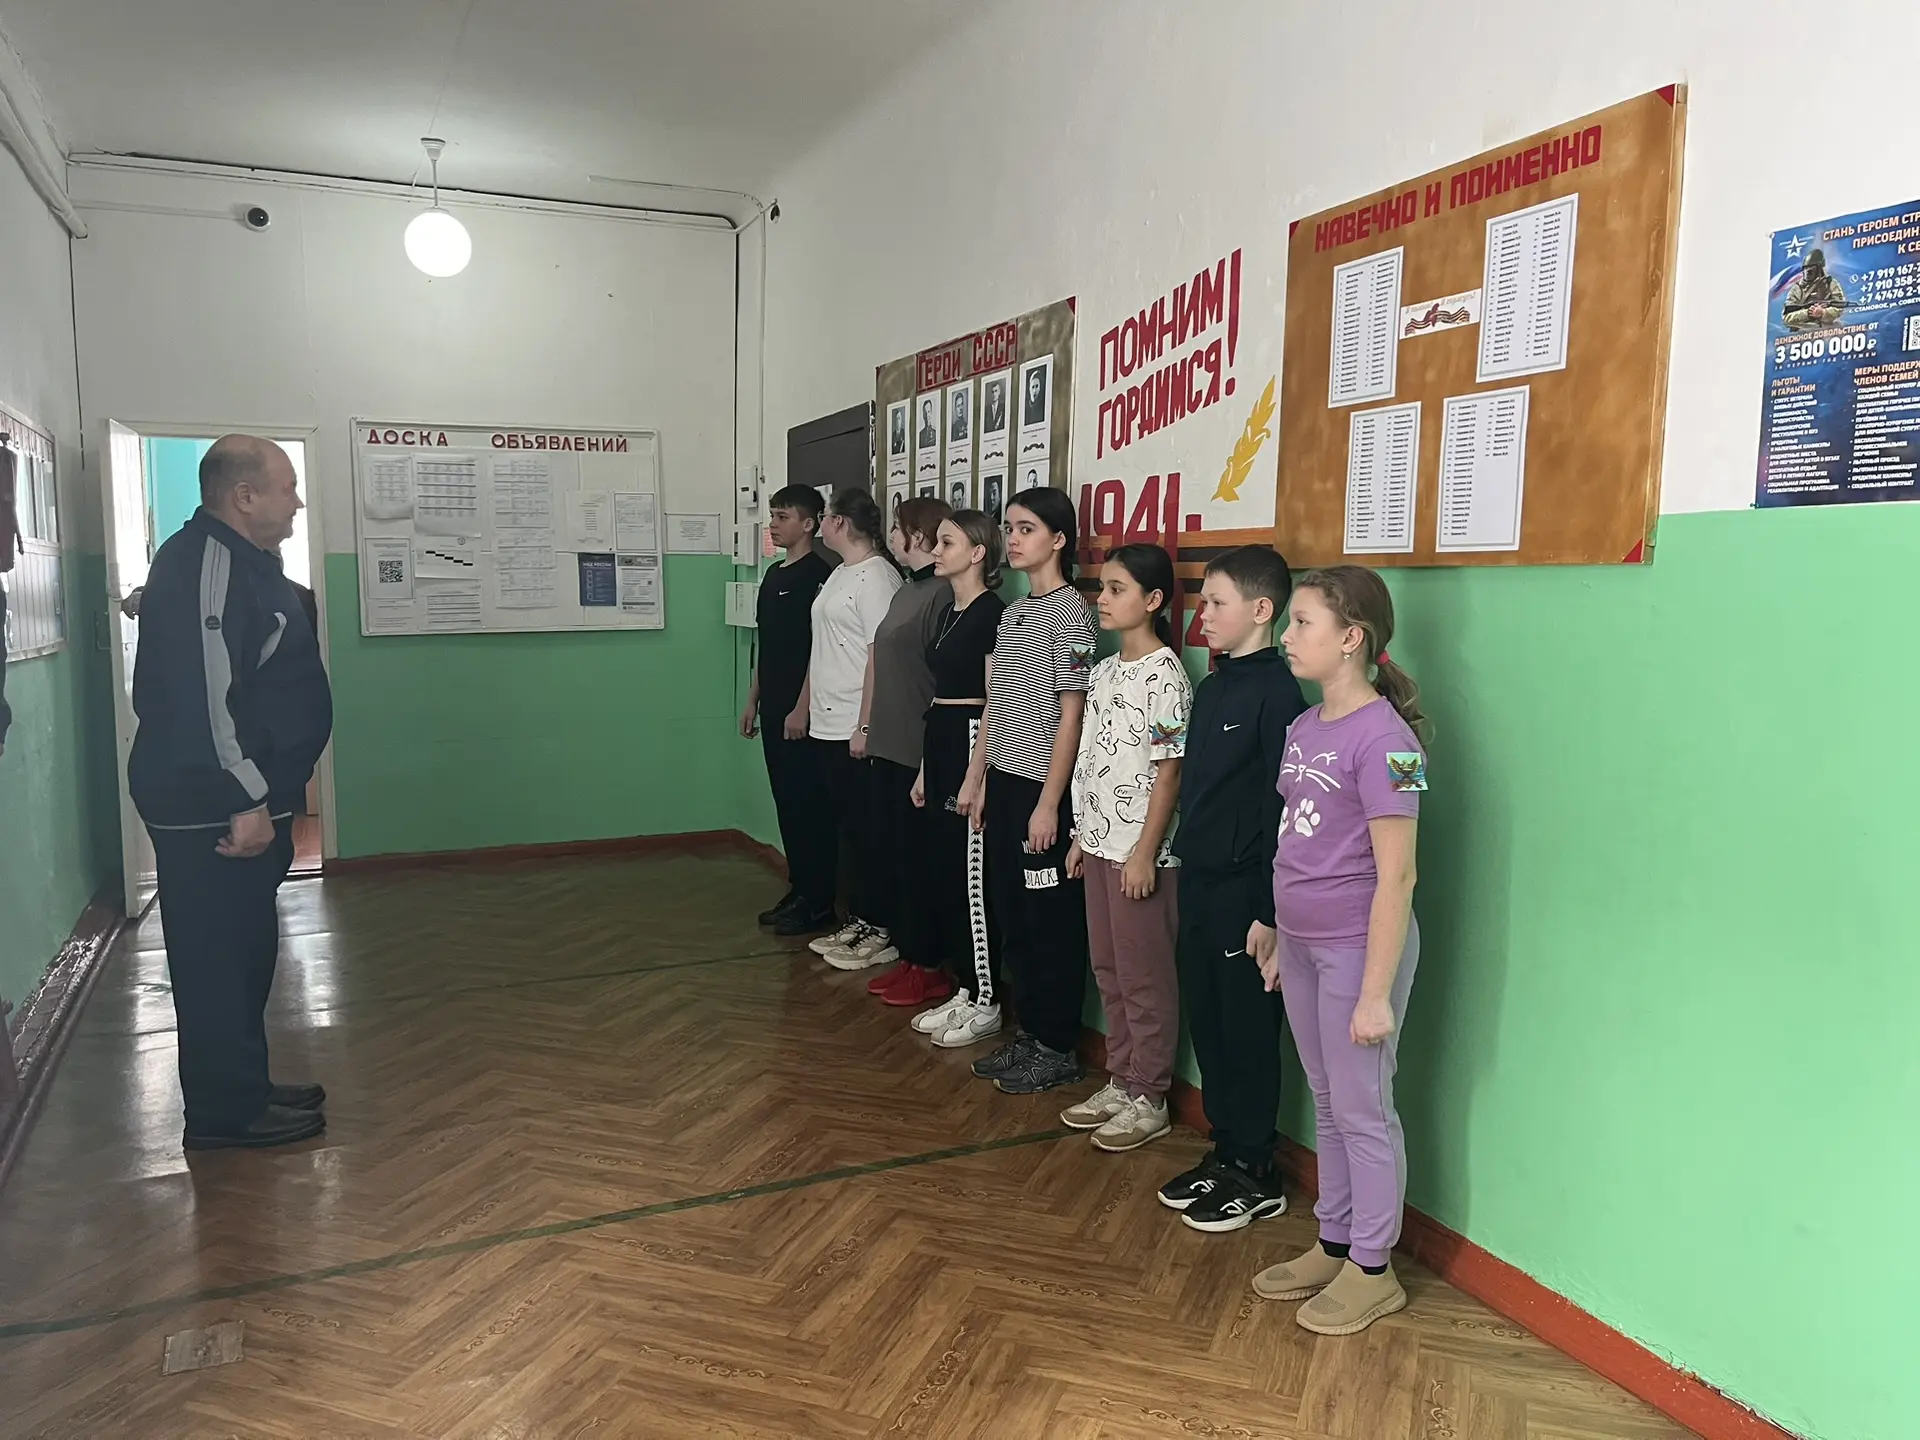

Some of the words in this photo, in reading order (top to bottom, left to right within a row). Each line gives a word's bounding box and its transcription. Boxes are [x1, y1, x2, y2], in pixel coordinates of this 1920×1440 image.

[1315, 190, 1417, 252] НАВЕЧНО
[1424, 182, 1442, 218] И
[1450, 125, 1602, 209] ПОИМЕННО
[1824, 226, 1854, 240] СТАНЬ
[1858, 216, 1899, 234] ГЕРОЕМ
[1898, 243, 1906, 254] К
[1862, 270, 1874, 281] +7
[1877, 267, 1895, 280] 919
[1861, 282, 1874, 292] +7
[1876, 279, 1892, 290] 910
[1860, 294, 1872, 304] +7
[1874, 290, 1904, 301] 47476
[1774, 333, 1812, 346] ДЕНЕЖНОЕ
[1814, 324, 1866, 339] ДОВОЛЬСТВИЕ
[1868, 322, 1878, 330] ОТ
[917, 348, 961, 391] ГЕРОИ
[972, 322, 1016, 373] СССР
[1775, 346, 1786, 364] 3
[1790, 340, 1825, 361] 500
[1854, 365, 1880, 376] МЕРЫ
[1854, 374, 1888, 386] ЧЛЕНОВ
[1889, 370, 1918, 382] СЕМЕЙ
[1772, 376, 1800, 388] ЛЬГОТЫ
[1778, 384, 1816, 396] ГАРАНТИИ
[367, 429, 449, 448] ДОСКА
[491, 433, 628, 453] ОБЪЯВЛЕНИЙ
